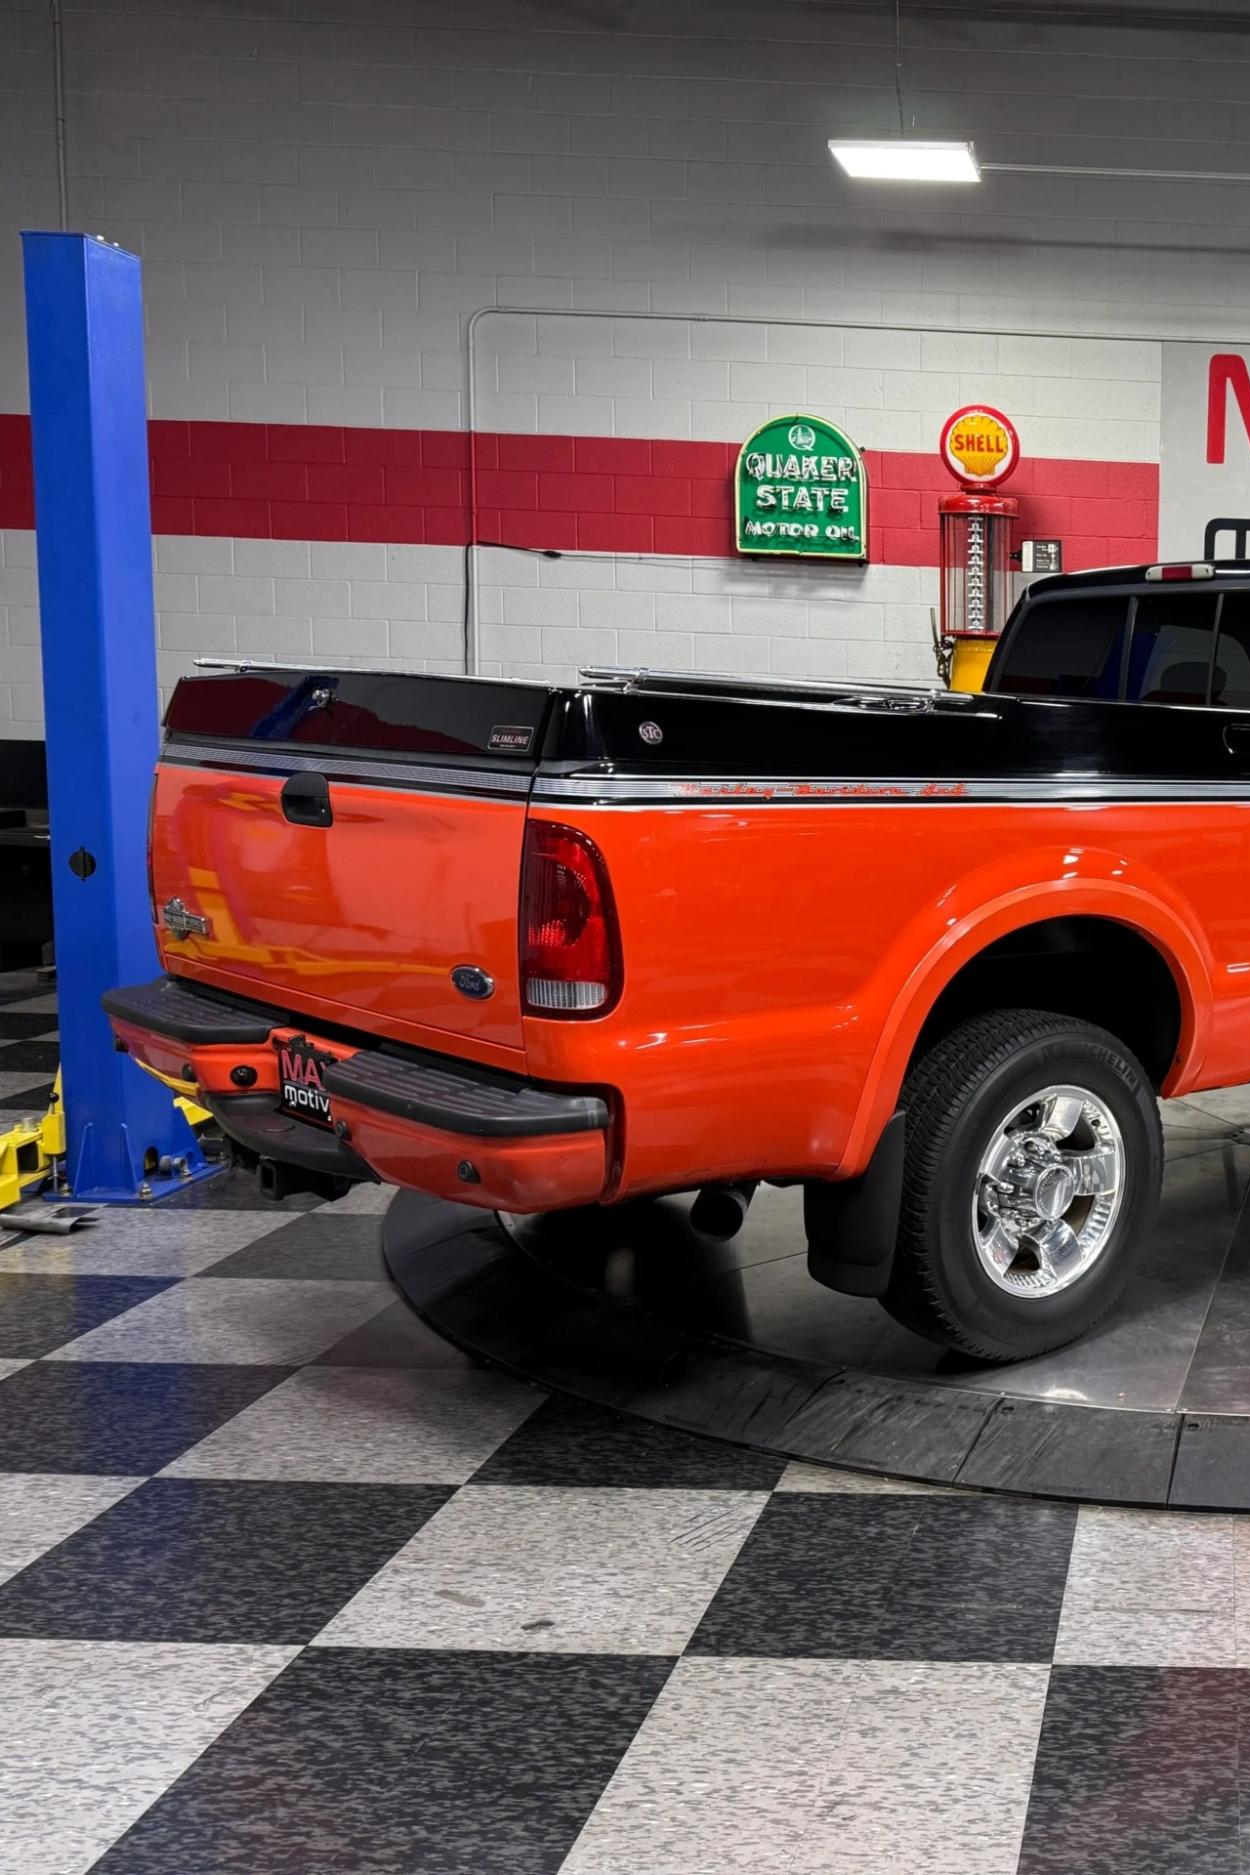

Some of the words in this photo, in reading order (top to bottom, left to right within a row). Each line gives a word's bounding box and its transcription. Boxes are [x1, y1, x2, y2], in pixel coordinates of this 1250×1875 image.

[954, 434, 1004, 453] SHELL
[746, 452, 857, 481] QUAKER
[756, 485, 849, 513] STATE
[745, 520, 819, 538] MOTOR
[825, 525, 860, 541] OIL
[490, 733, 529, 745] SLIMLINE
[284, 1085, 330, 1112] motiv
